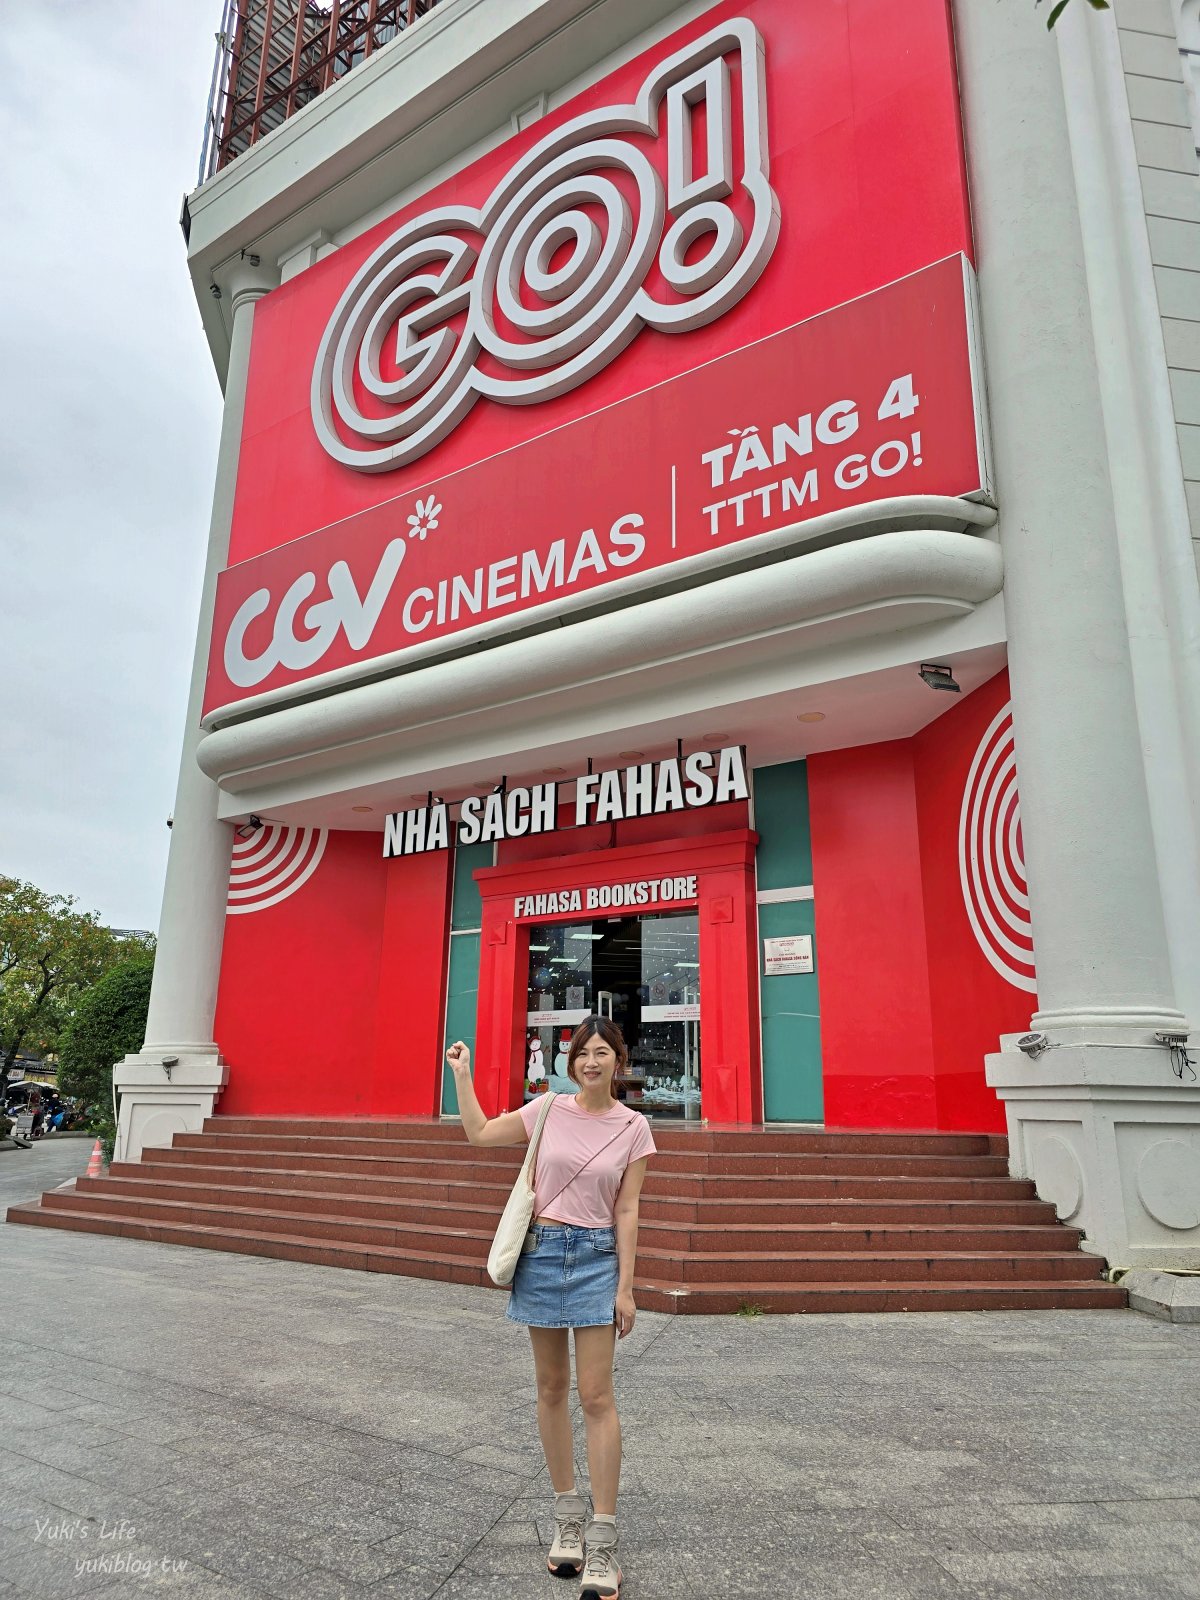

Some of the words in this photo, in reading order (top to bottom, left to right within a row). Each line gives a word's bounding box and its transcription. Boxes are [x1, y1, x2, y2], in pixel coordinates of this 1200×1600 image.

[311, 17, 780, 473] GO!
[702, 400, 859, 489] TẦNG
[877, 373, 920, 421] 4
[702, 468, 819, 536] TTTM
[833, 431, 923, 490] GO!
[224, 538, 406, 687] CGV
[402, 513, 646, 633] CINEMAS
[382, 797, 450, 858] NHÀ
[459, 782, 558, 845] SÁCH
[575, 745, 751, 826] FAHASA
[514, 888, 582, 918] FAHASA
[586, 875, 698, 910] BOOKSTORE
